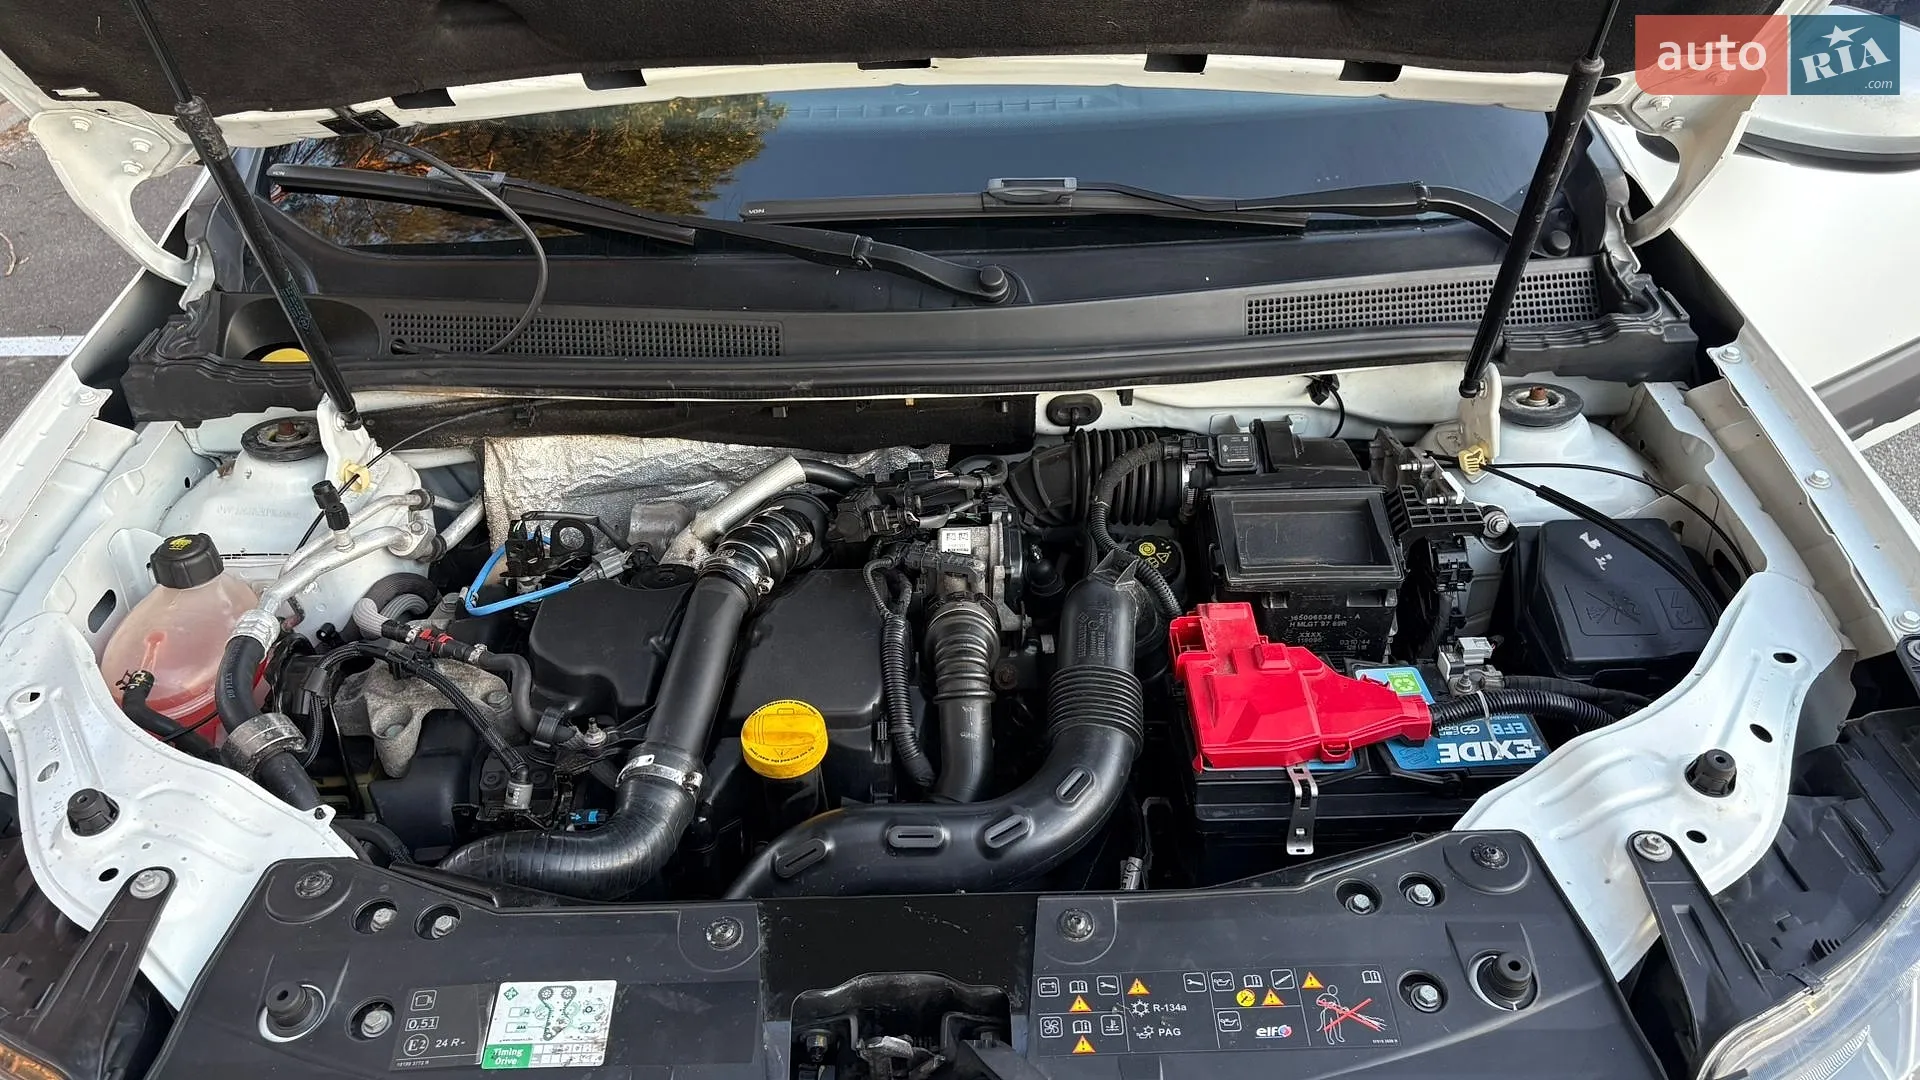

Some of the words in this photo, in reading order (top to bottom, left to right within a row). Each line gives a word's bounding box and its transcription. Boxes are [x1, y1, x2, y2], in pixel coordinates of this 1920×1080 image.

[1491, 722, 1528, 735] EFB
[1438, 739, 1541, 763] EXIDE
[1152, 1003, 1187, 1012] R-134a
[408, 1018, 435, 1030] 0,51
[1158, 1027, 1182, 1037] PAG
[1256, 1026, 1278, 1037] elf
[435, 1038, 449, 1048] 24
[493, 1047, 524, 1058] Timing
[495, 1056, 518, 1065] Drive
